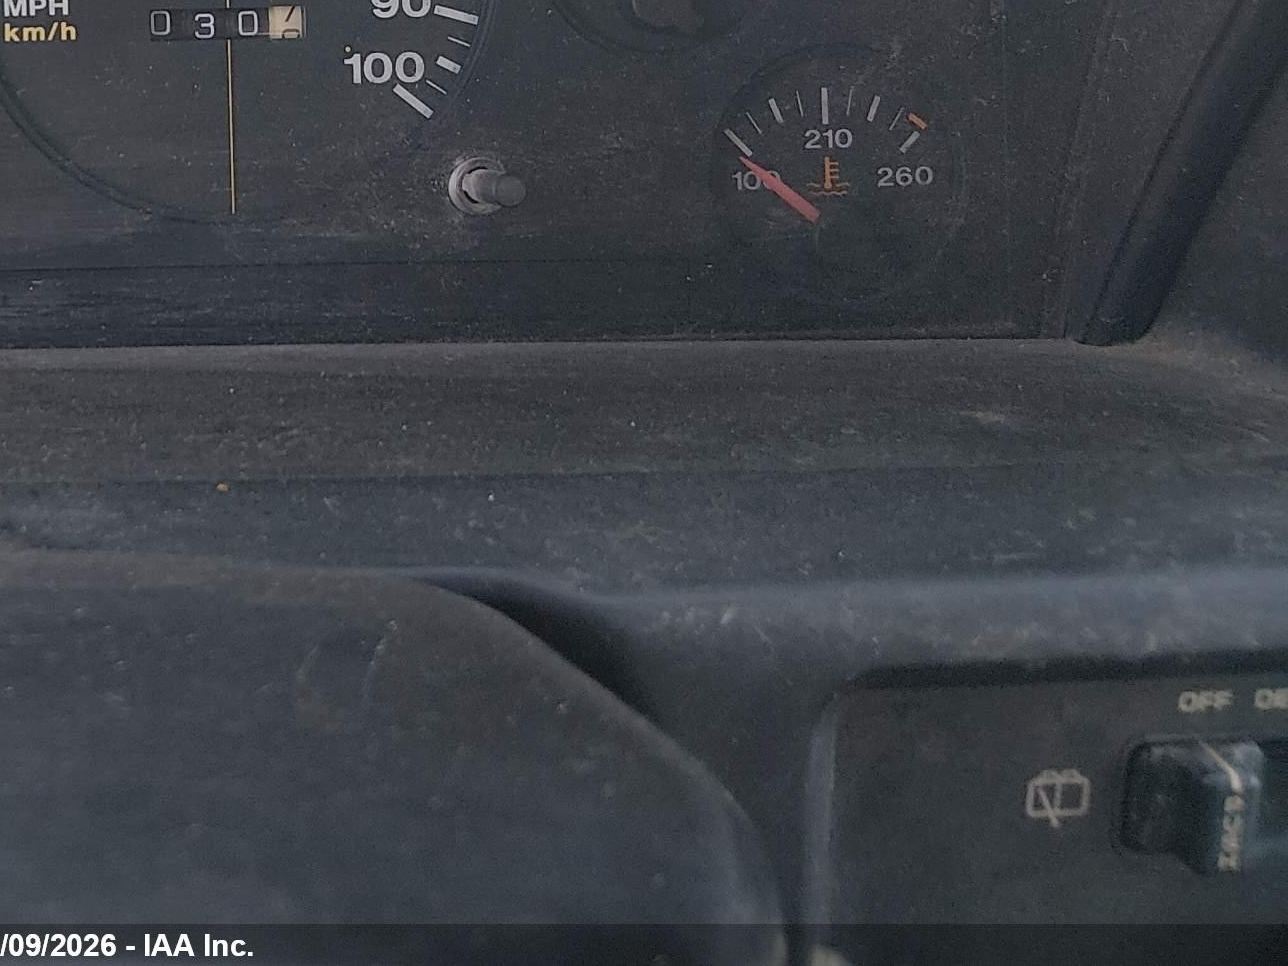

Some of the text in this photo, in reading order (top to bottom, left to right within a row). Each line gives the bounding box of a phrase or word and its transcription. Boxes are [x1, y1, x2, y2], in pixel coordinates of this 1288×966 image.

[3, 20, 77, 42] km/h
[344, 52, 424, 84] 100
[804, 129, 853, 148] 210
[876, 166, 934, 187] 260
